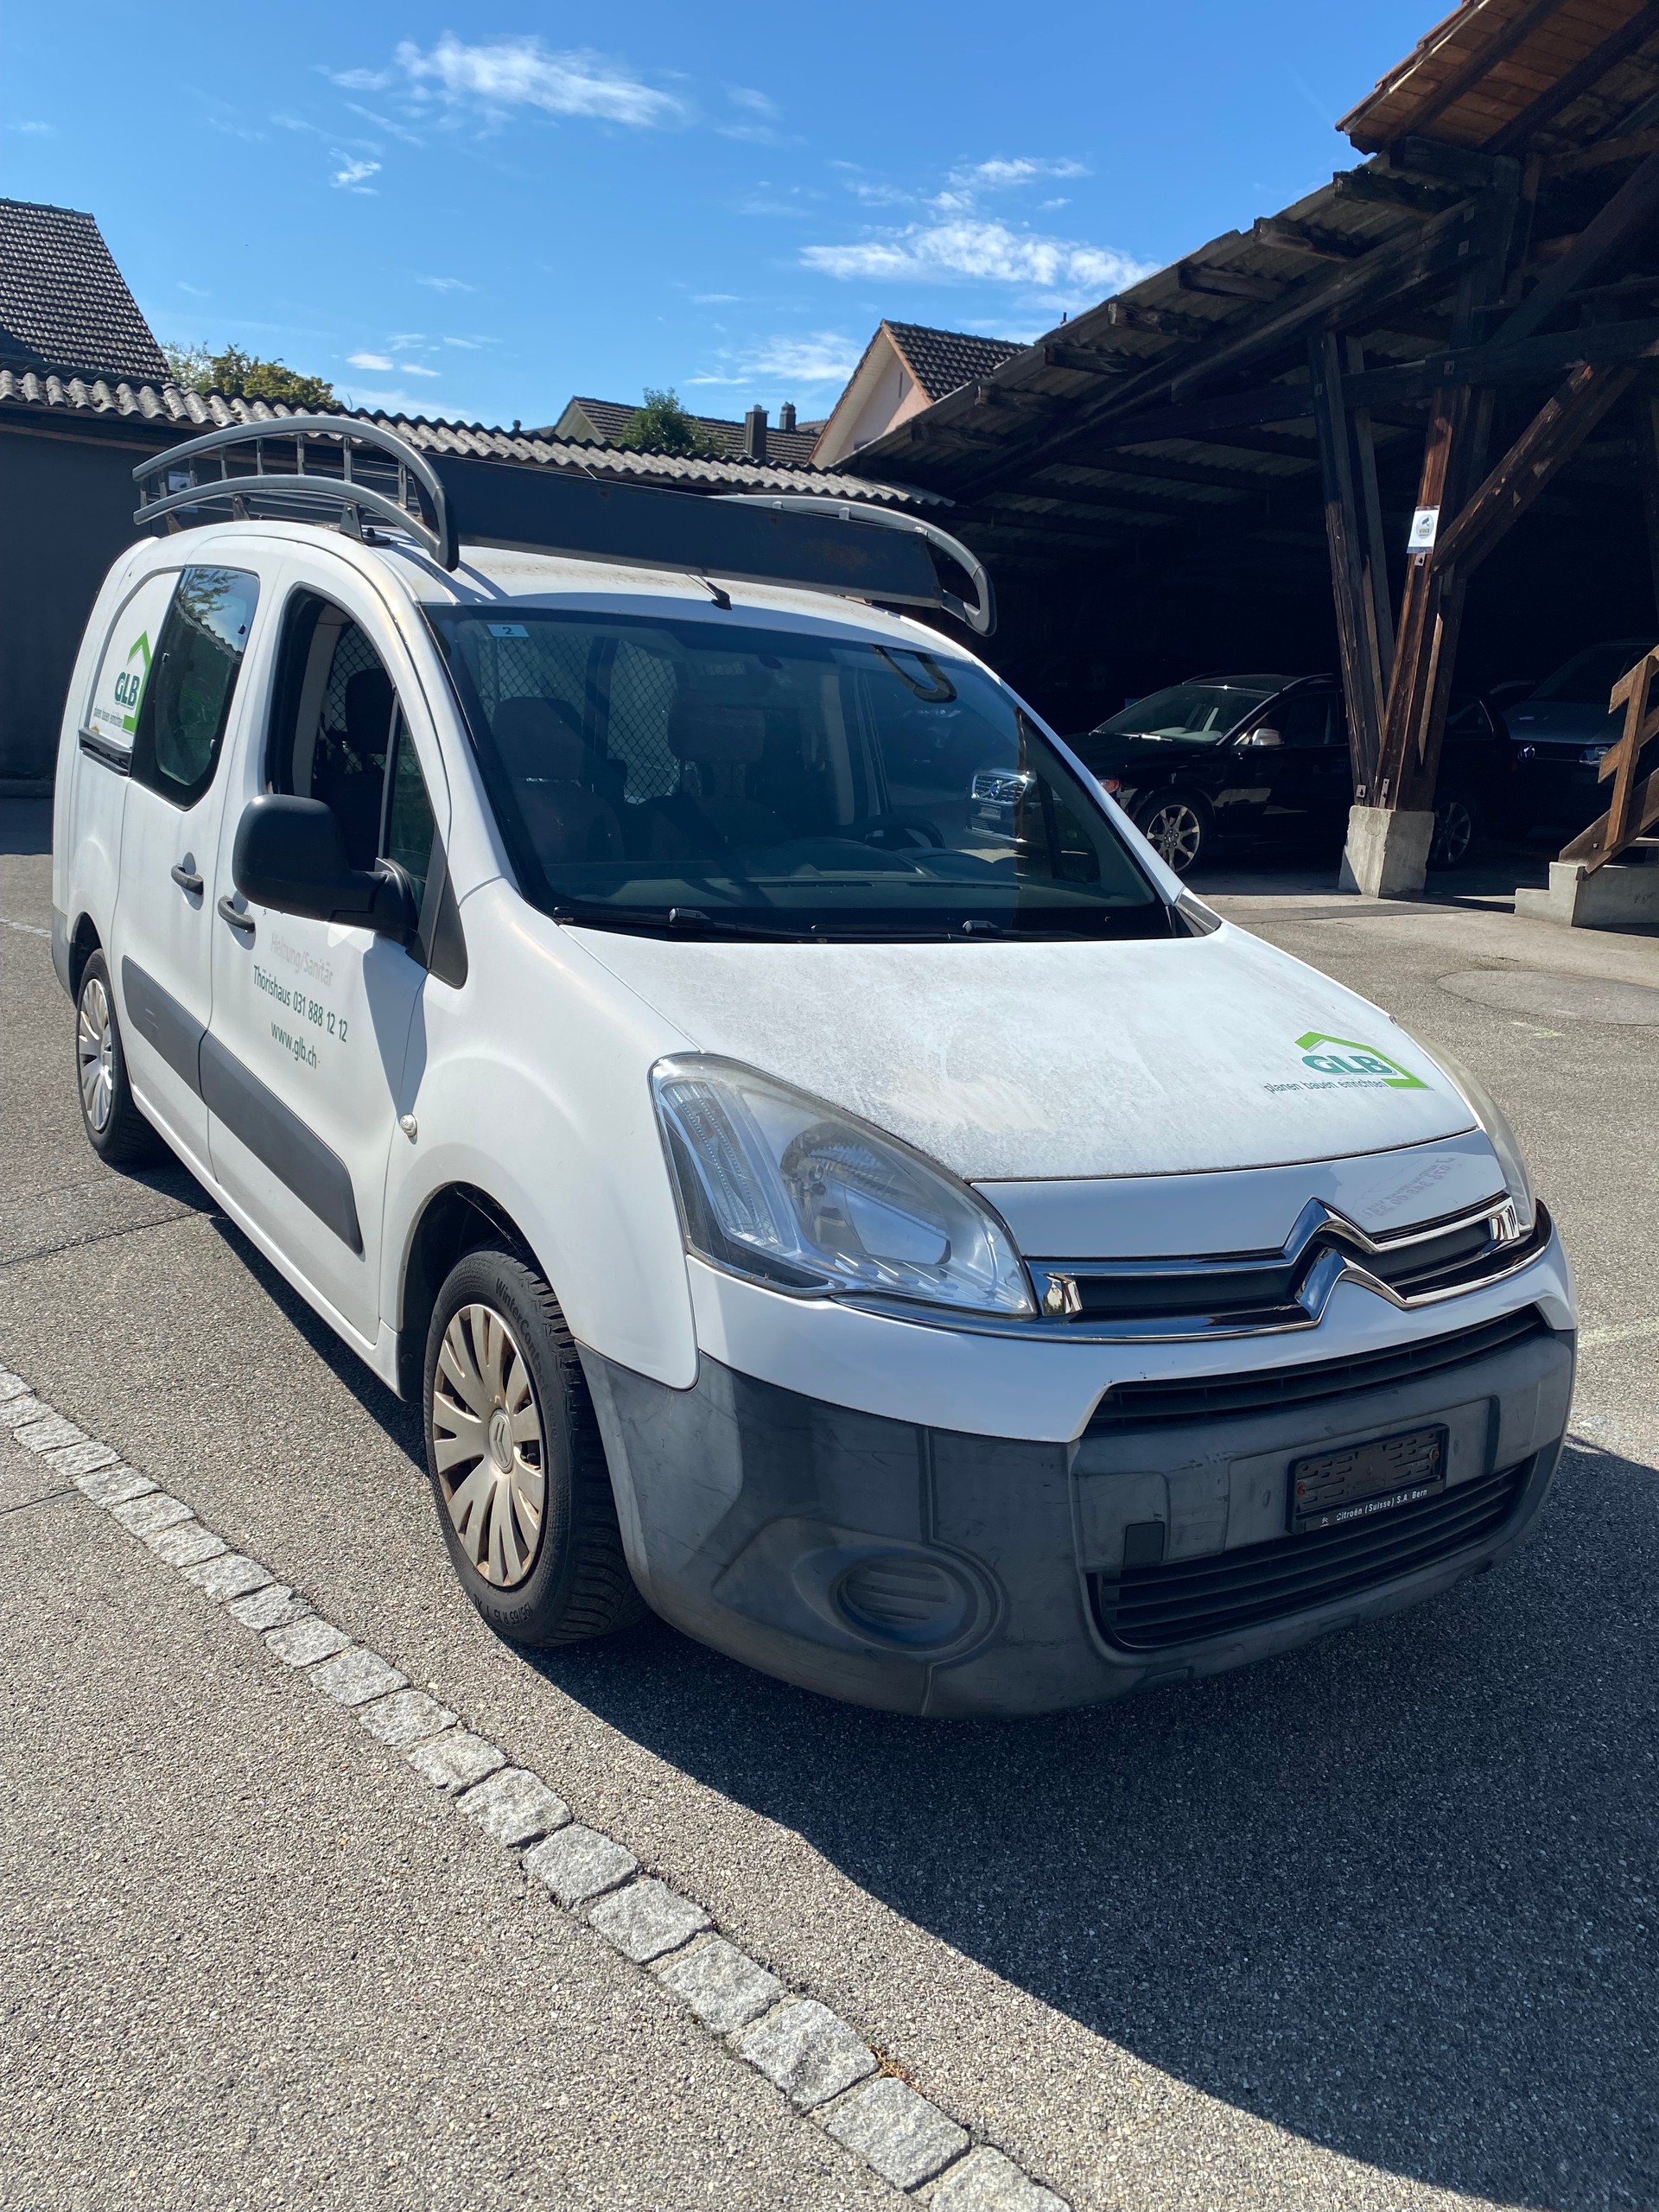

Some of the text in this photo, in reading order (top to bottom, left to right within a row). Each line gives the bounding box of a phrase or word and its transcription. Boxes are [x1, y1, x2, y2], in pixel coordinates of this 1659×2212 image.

[502, 626, 514, 635] 2
[115, 671, 140, 708] GLB
[253, 964, 347, 1043] Thörishaus 031 888 12 12
[270, 1021, 317, 1069] www.glb.ch
[1301, 1055, 1395, 1075] GLB
[1264, 1078, 1389, 1094] planen bauen einrichten
[1336, 1507, 1363, 1521] Citroën
[1364, 1497, 1395, 1515] (Suisse)
[1411, 1488, 1427, 1499] Bern
